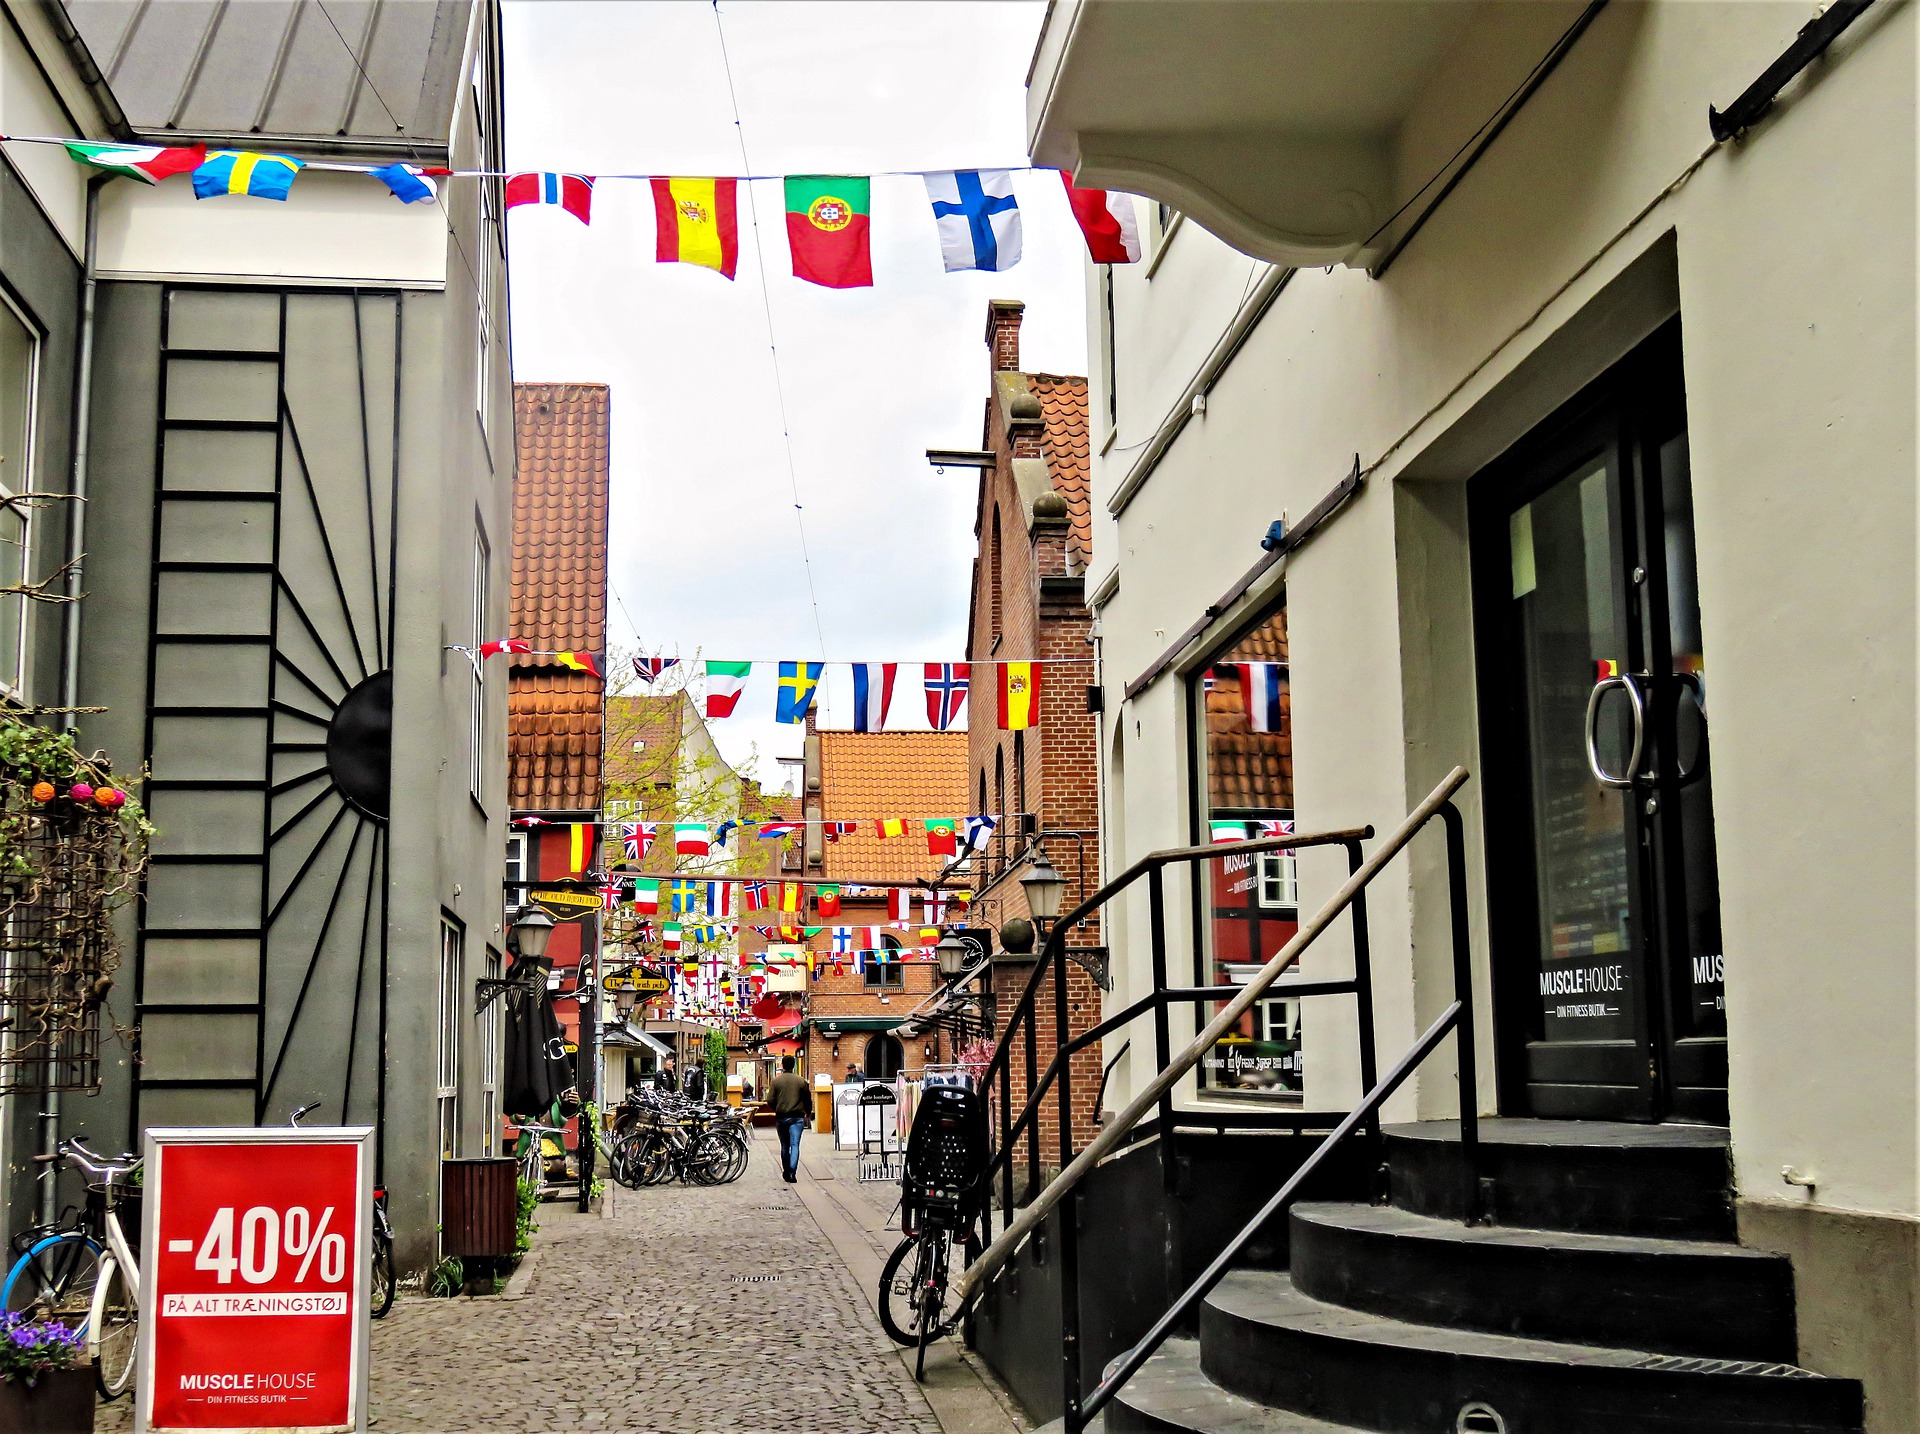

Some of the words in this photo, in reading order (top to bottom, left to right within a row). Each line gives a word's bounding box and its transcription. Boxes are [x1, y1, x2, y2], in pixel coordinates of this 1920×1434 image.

[652, 980, 665, 989] pub
[1556, 1005, 1567, 1018] DIN
[1567, 1004, 1588, 1018] FITNESS
[1588, 1003, 1606, 1017] BUTIK
[168, 1206, 346, 1285] -40%
[168, 1296, 187, 1313] PÅ
[193, 1299, 220, 1313] ALT
[224, 1297, 342, 1312] TRÆNINGSTØJ
[180, 1374, 255, 1390] MUSCLE
[257, 1372, 317, 1389] HOUSE
[207, 1396, 223, 1404] DIN
[224, 1395, 259, 1404] FITNESS
[261, 1395, 287, 1403] BUTIK
